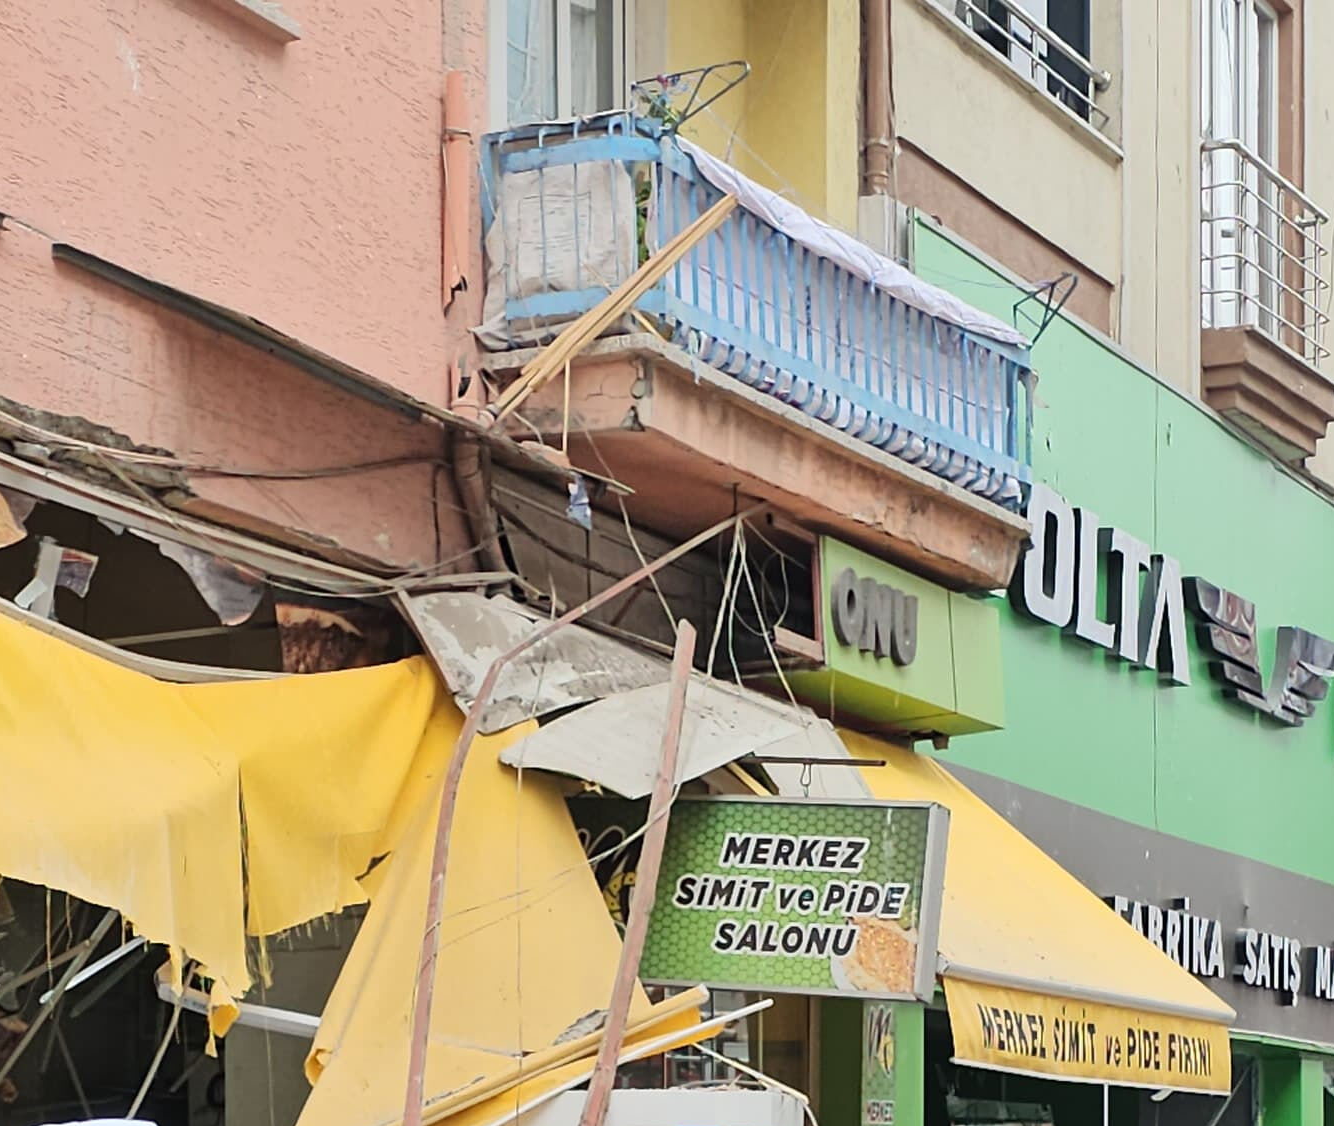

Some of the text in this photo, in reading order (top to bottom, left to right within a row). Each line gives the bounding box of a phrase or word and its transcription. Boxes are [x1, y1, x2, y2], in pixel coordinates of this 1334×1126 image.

[1023, 483, 1191, 686] OLTA
[722, 836, 867, 869] MERKEZ
[778, 887, 815, 910] ve
[714, 922, 857, 956] SALONU
[1242, 927, 1302, 1007] SATIŞ
[977, 1003, 1047, 1059] MERKEZ
[1105, 1034, 1122, 1068] ve
[1167, 1033, 1212, 1077] FIRINI
